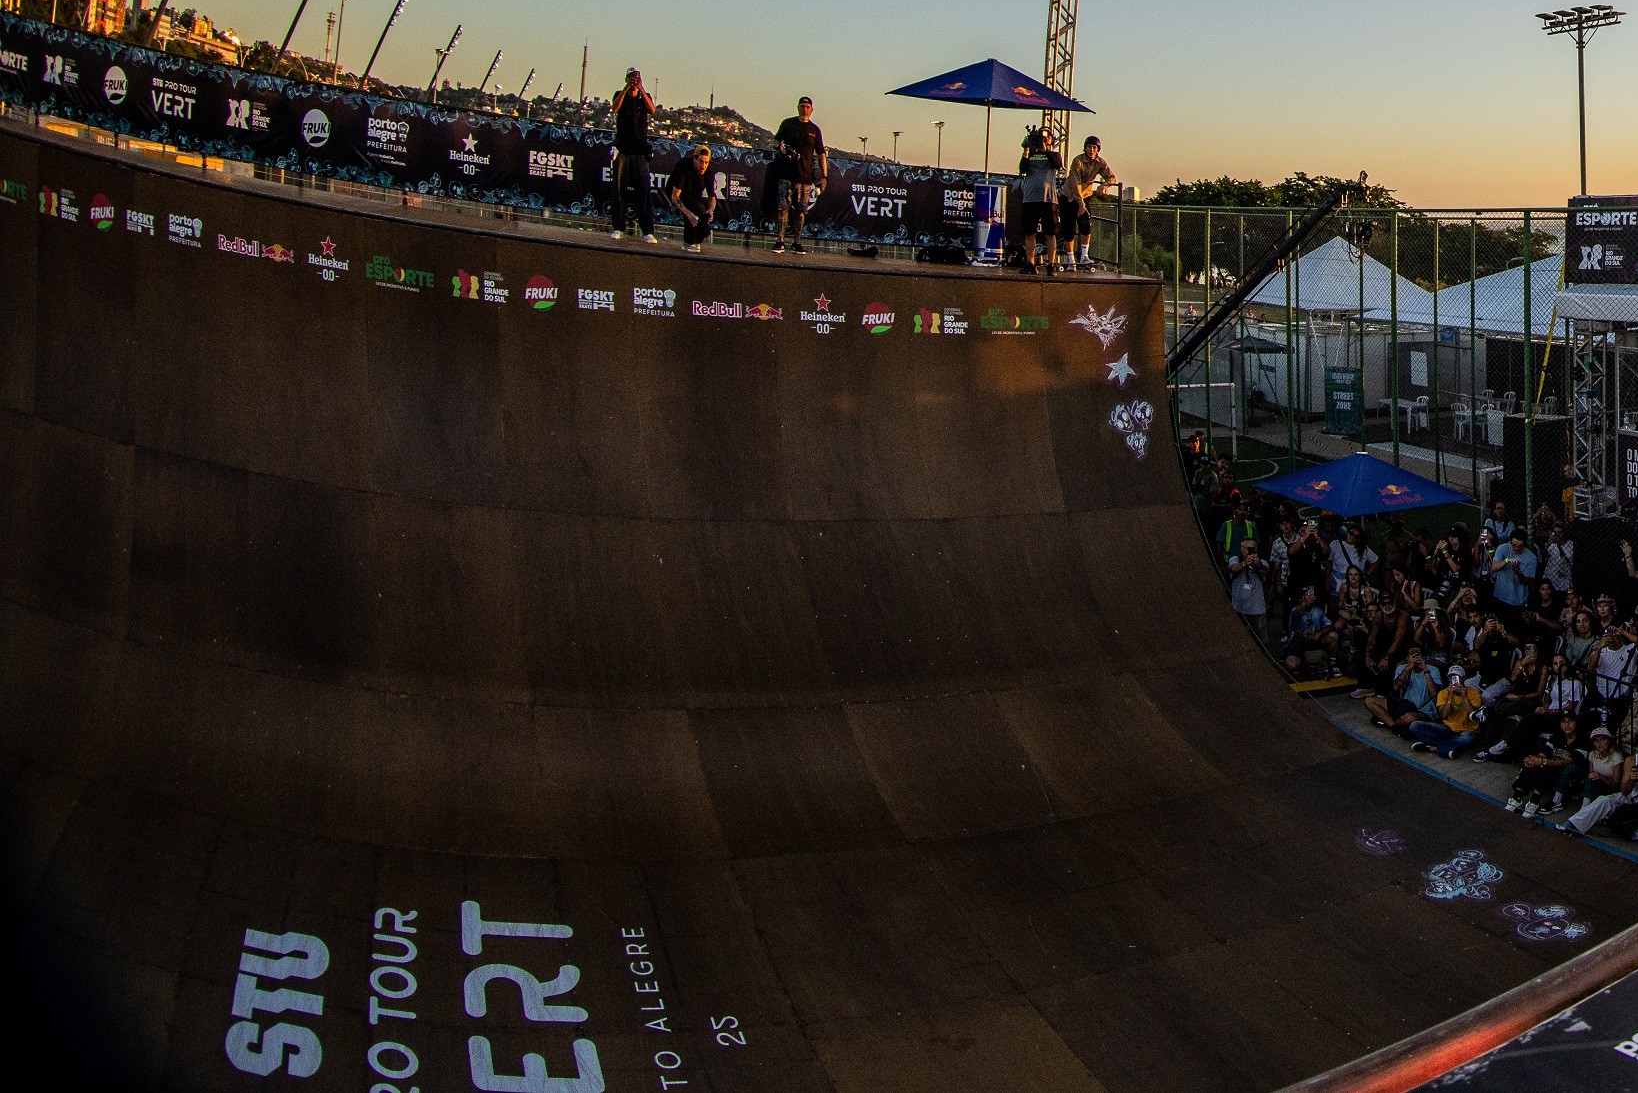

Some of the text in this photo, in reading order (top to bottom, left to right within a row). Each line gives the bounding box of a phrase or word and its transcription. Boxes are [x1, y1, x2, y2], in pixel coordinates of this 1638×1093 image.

[164, 80, 178, 91] PRO
[179, 83, 197, 95] TOUR
[151, 89, 196, 121] VERT
[368, 117, 398, 131] porto
[368, 127, 397, 143] alegre
[366, 141, 408, 153] PREFEITURA
[449, 149, 491, 165] Heineken
[529, 150, 574, 168] FGSKT
[730, 185, 751, 193] GRANDE
[852, 184, 908, 197] STU PRO TOUR
[944, 189, 974, 200] porto
[851, 194, 907, 219] VERT
[944, 198, 974, 211] alegre
[90, 207, 114, 219] FRUKI
[126, 210, 154, 225] FGSKT
[1575, 211, 1638, 226] ESPORTE
[168, 213, 192, 227] porto
[168, 225, 192, 239] alegre
[168, 235, 202, 248] PREFEITURA
[218, 233, 260, 257] Red Bull
[308, 253, 349, 271] Heineken
[484, 287, 509, 297] GRANDE
[525, 287, 558, 299] FRUKI
[578, 289, 614, 301] FGSKT
[634, 287, 663, 299] porto
[494, 295, 506, 303] SUL
[634, 297, 663, 308] alegre
[634, 308, 676, 318] PREFEITURA
[692, 300, 742, 319] Red Bull
[800, 311, 846, 323] Heineken
[862, 312, 895, 325] FRUKI
[944, 321, 968, 329] GRANDE
[944, 327, 954, 335] DO
[1332, 391, 1354, 400] STREET
[1336, 401, 1352, 410] ZONE
[1626, 448, 1632, 461] O
[1626, 461, 1638, 474] DO
[1626, 473, 1632, 485] O
[368, 907, 419, 1025] TOUR
[622, 925, 674, 1033] ALEGRE
[224, 927, 330, 1079] STU
[710, 1015, 748, 1047] 25
